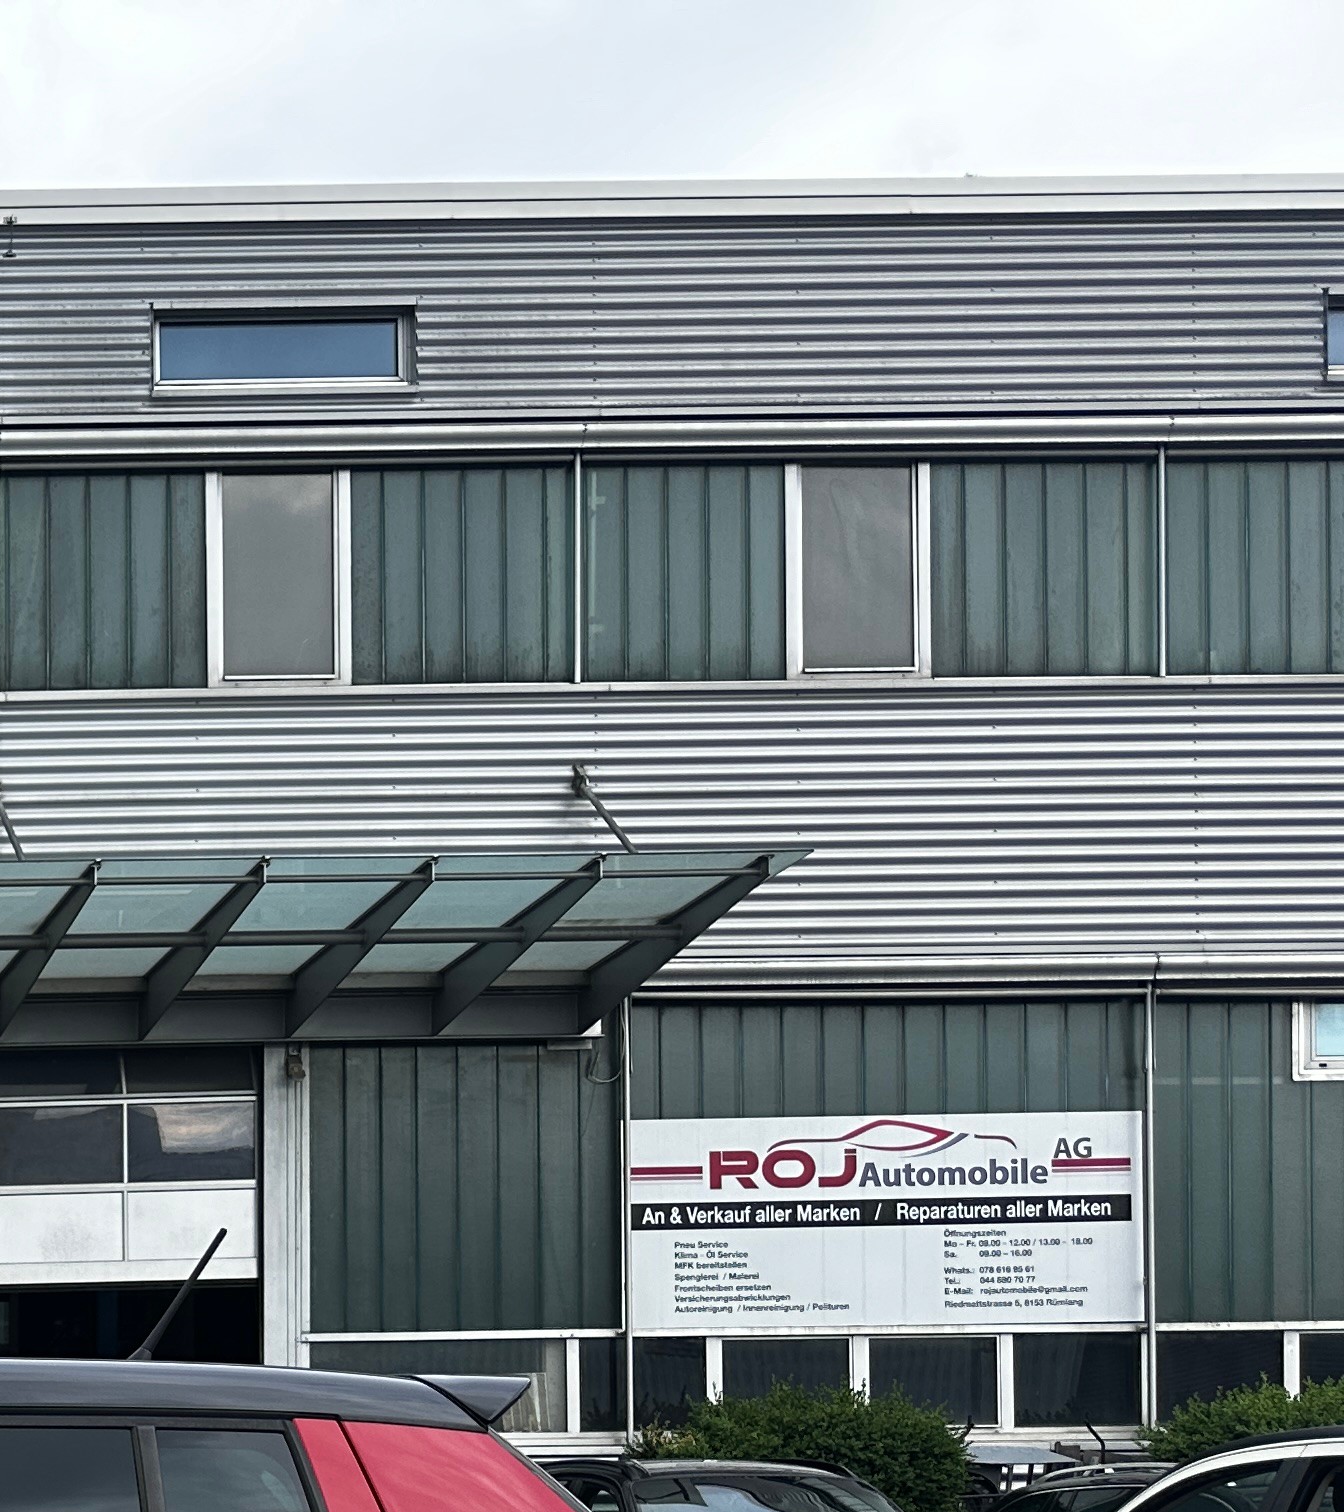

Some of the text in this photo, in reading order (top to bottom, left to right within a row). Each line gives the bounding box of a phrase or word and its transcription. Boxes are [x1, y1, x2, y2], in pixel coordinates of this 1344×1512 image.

[709, 1137, 1092, 1189] ROJ Automobile AG
[642, 1199, 1111, 1224] An & Verkauf aller Marken / Reparaturen aller Marken
[944, 1229, 1006, 1238] Öffnungszeiten
[674, 1273, 719, 1282] Spenglerei
